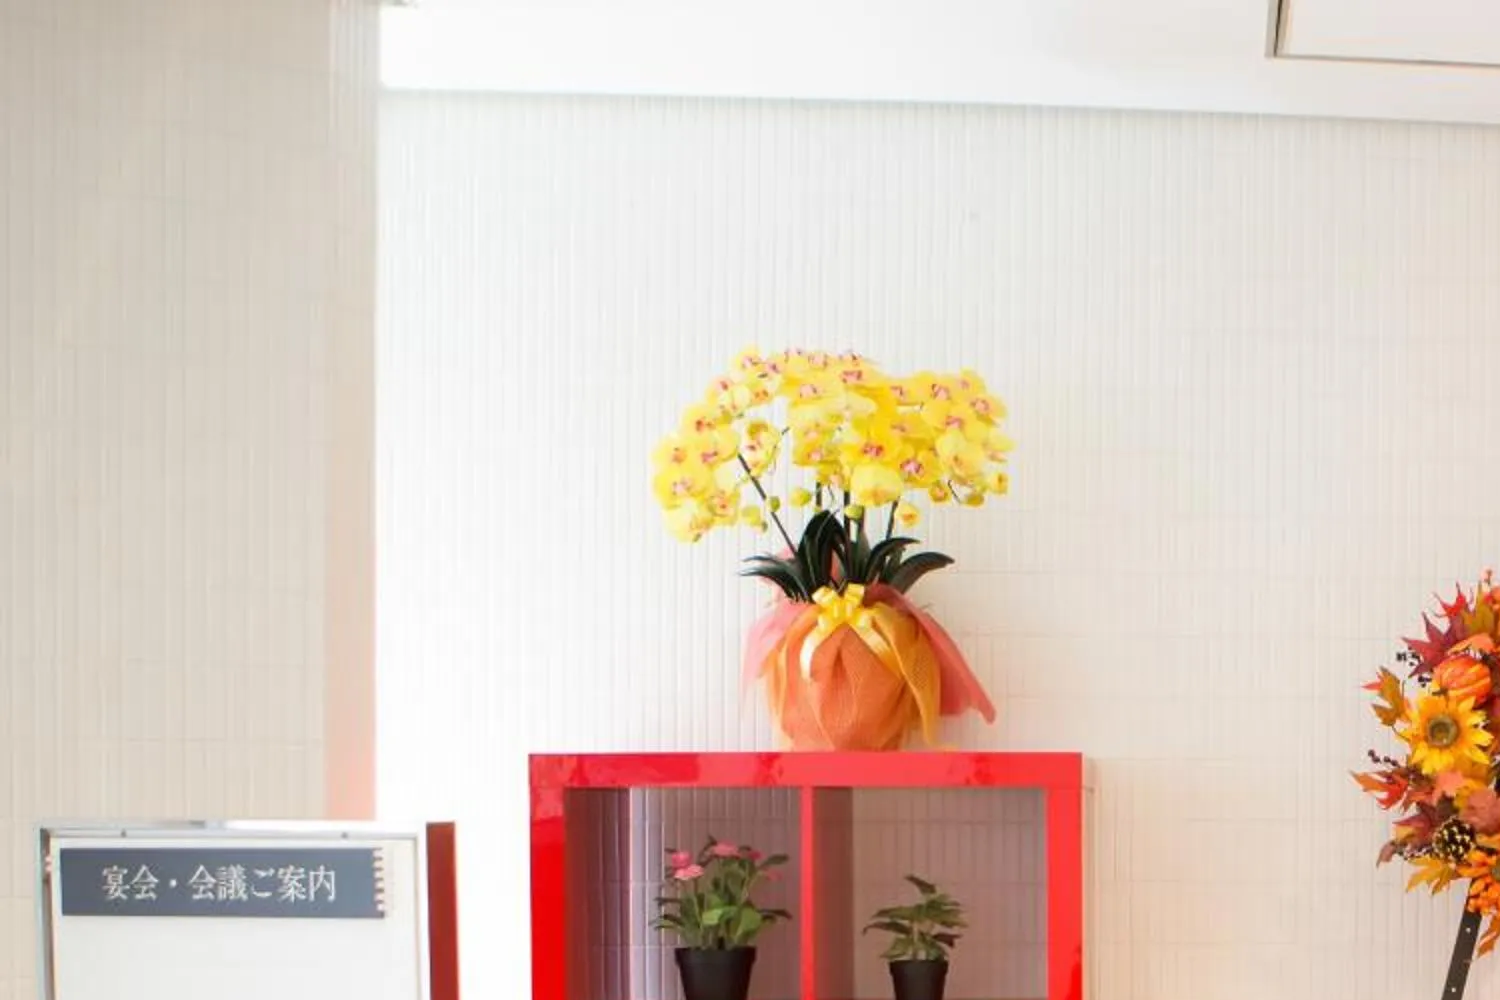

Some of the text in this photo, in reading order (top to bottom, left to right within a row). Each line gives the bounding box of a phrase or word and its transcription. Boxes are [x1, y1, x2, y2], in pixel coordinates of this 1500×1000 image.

[102, 864, 336, 902] 宴会・会議ご案内
